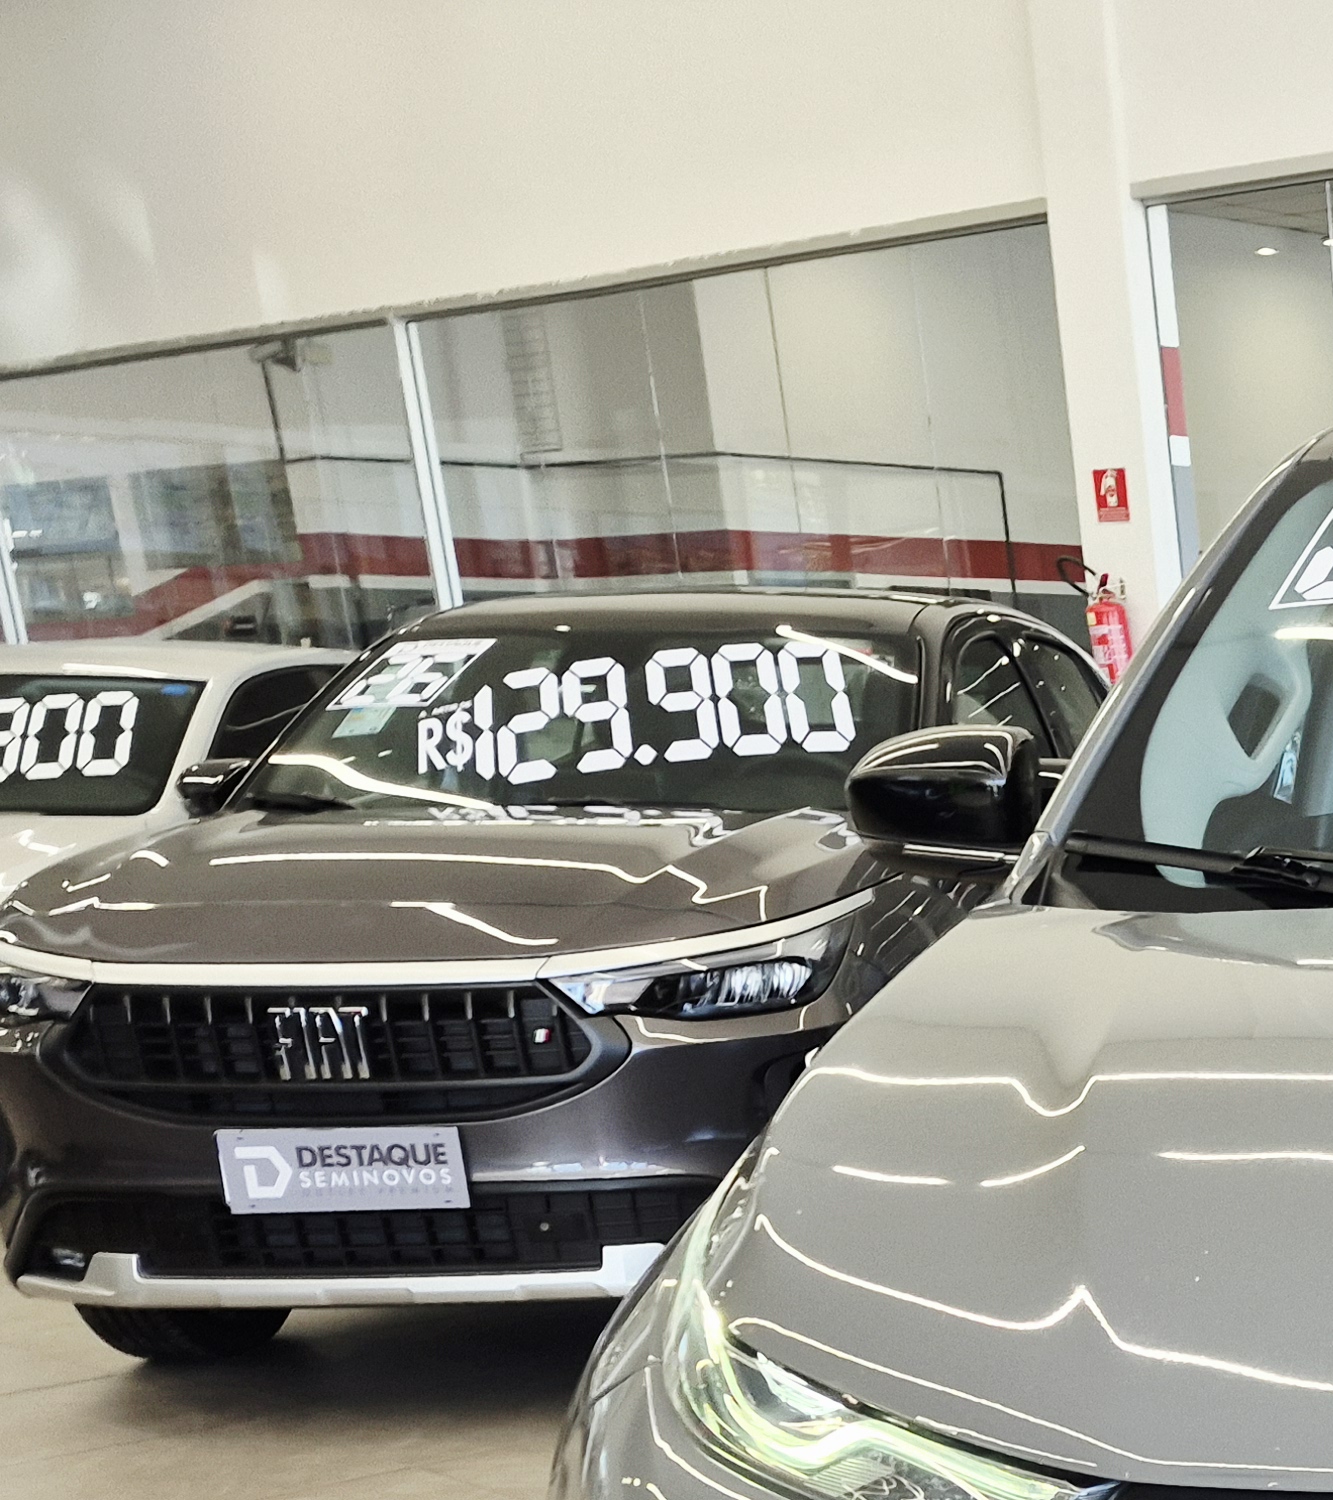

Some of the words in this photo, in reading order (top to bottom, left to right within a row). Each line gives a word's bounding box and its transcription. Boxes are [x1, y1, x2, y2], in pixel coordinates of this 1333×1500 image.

[267, 1006, 370, 1081] FIAT
[295, 1143, 449, 1168] DESTAQUE
[299, 1168, 452, 1189] SEMINOVOS
